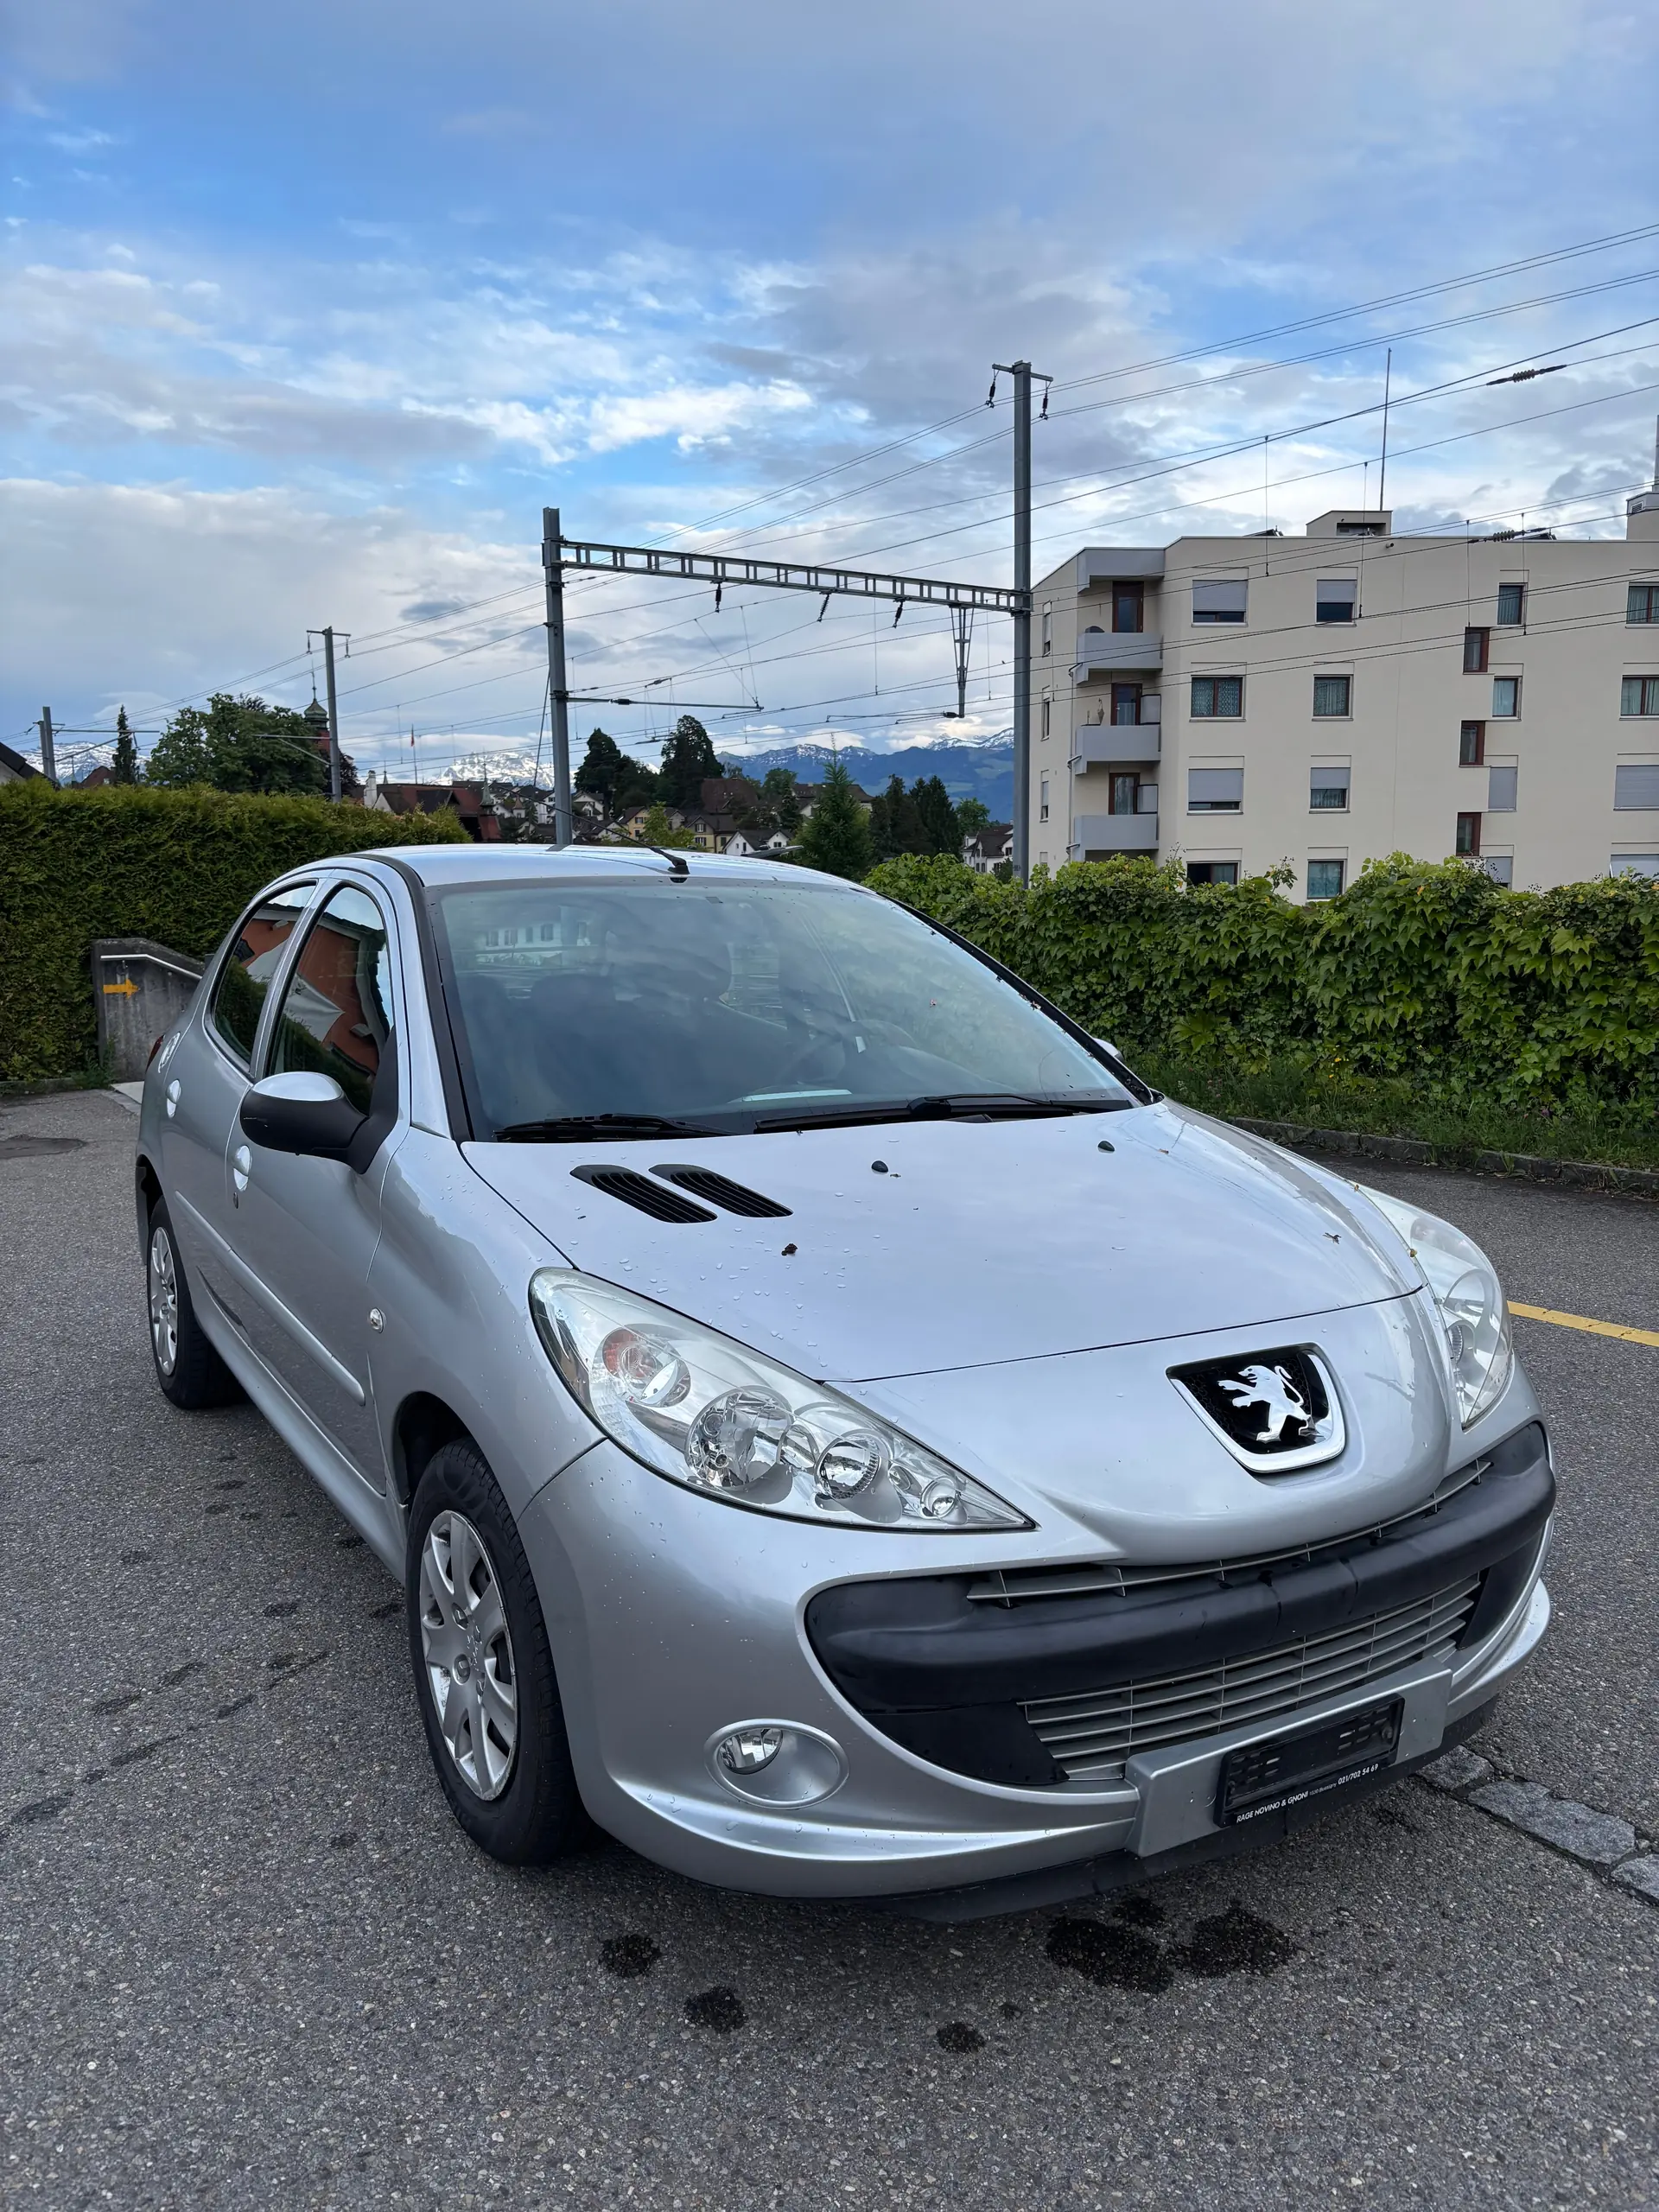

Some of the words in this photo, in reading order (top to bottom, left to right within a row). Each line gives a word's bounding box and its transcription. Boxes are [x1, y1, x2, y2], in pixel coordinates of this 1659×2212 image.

[1255, 1802, 1280, 1816] NOVINO
[1287, 1791, 1309, 1804] GNONI
[1338, 1770, 1361, 1785] 021/702
[1362, 1767, 1370, 1776] 54
[1370, 1763, 1379, 1772] 69
